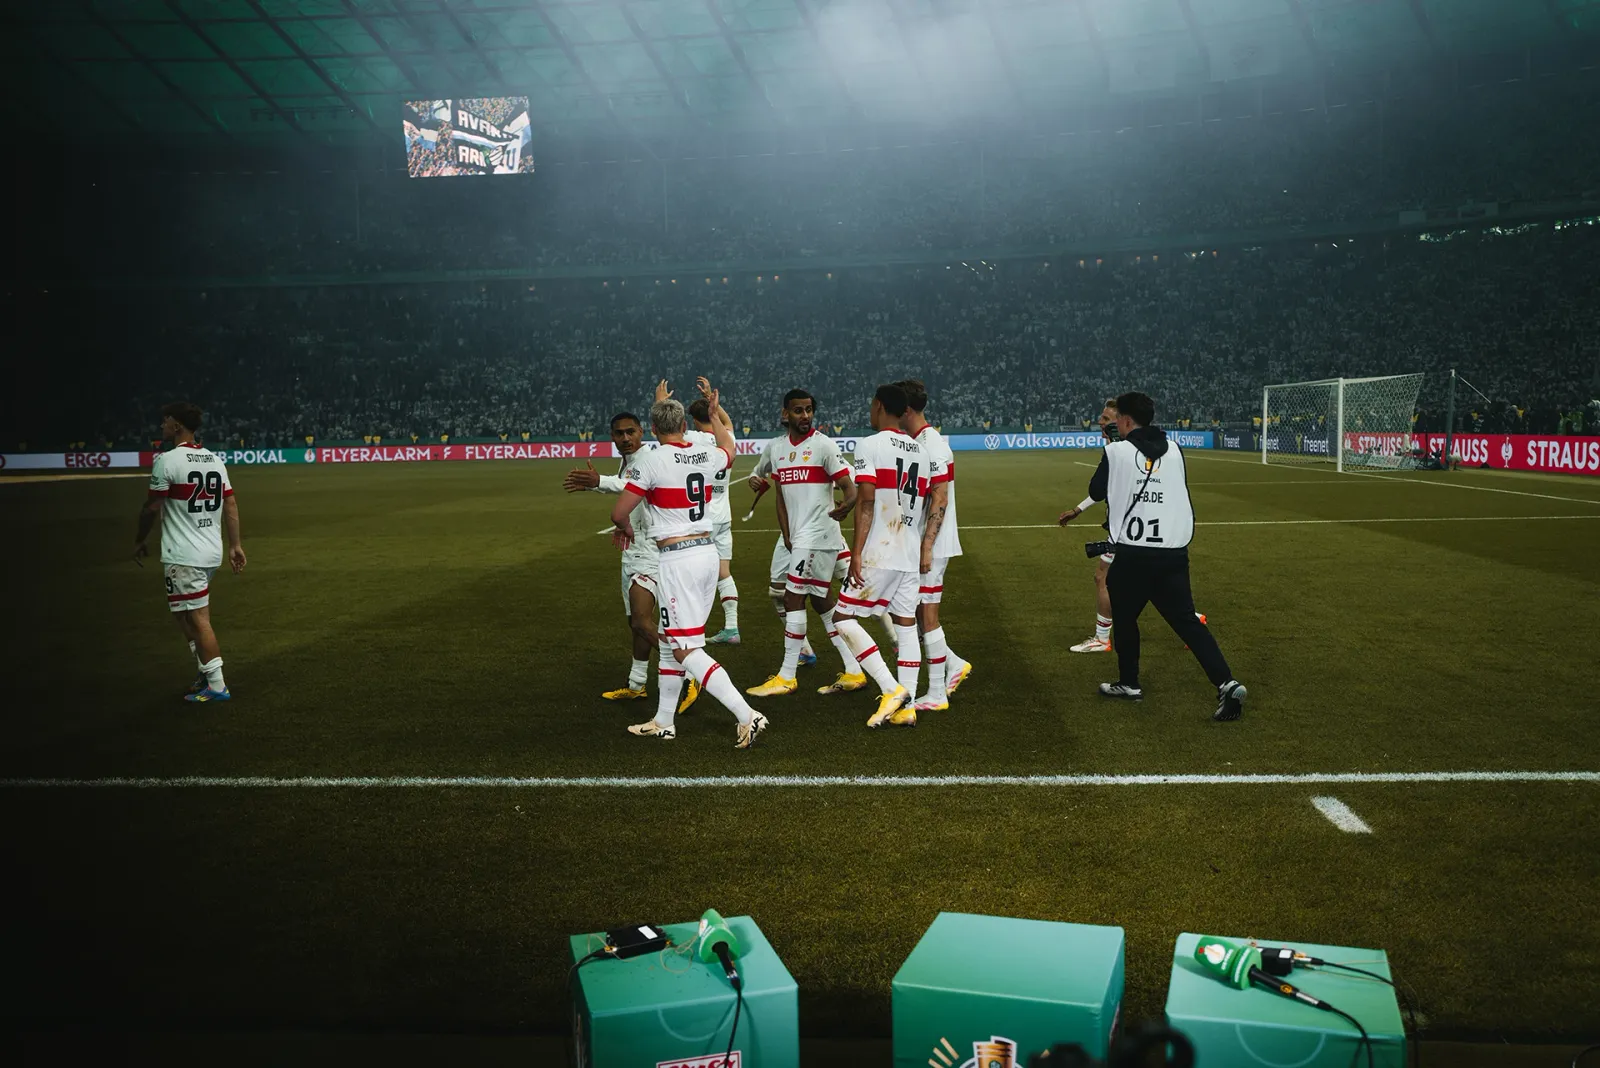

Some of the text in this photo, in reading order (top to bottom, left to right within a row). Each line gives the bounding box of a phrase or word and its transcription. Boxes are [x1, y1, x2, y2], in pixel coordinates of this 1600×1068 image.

[1005, 433, 1107, 449] Volkswagen
[1166, 431, 1205, 448] lkswagen
[1223, 434, 1329, 453] freenet frenet freenet
[216, 449, 287, 464] B-POKAL
[322, 447, 431, 462] FLYERALARM
[465, 444, 576, 460] FLYERALARM
[1429, 437, 1489, 463] STAUSS
[64, 452, 111, 468] ERGO
[187, 470, 222, 513] 29
[896, 457, 919, 510] 14
[685, 472, 705, 523] 9
[1126, 516, 1164, 543] 01
[795, 559, 806, 577] 4
[660, 607, 670, 628] 9
